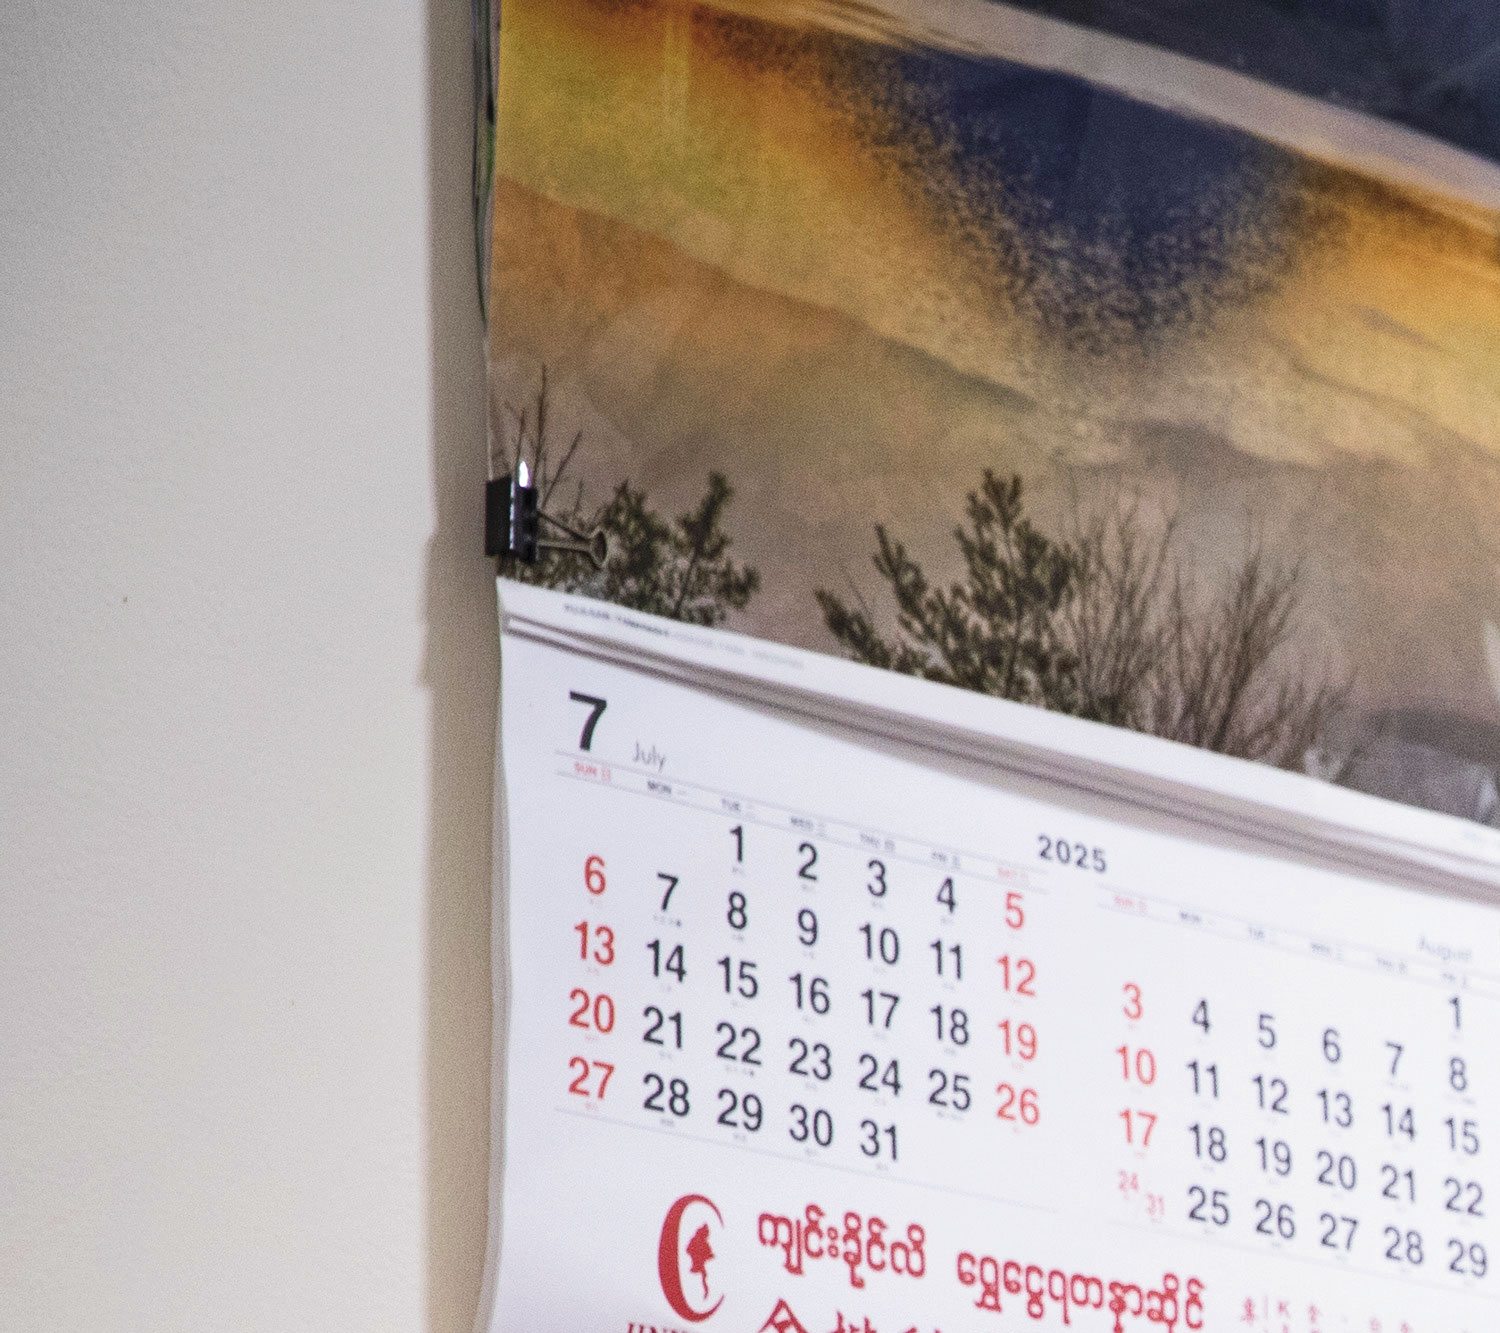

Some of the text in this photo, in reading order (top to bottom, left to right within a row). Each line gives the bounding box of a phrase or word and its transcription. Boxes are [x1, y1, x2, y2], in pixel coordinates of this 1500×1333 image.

[568, 690, 667, 773] 7 July
[729, 824, 1026, 931] 1 2 3 4 5
[1037, 830, 1109, 876] 2025
[583, 854, 1037, 998] 6 7 8 9 10 11 12
[574, 920, 1039, 1062] 13 14 15 16 17 18 19
[1122, 981, 1144, 1022] 3
[1191, 998, 1212, 1034] 4
[1256, 1011, 1278, 1051] 5
[1320, 1026, 1343, 1066] 6
[1384, 1040, 1406, 1078] 7
[1447, 1055, 1469, 1094] 8
[1447, 994, 1463, 1031] 1
[567, 1055, 899, 1161] 27 28 29 30 31
[568, 987, 1041, 1126] 20 21 22 23 24 25 26
[1115, 1043, 1157, 1086] 10
[1186, 1059, 1220, 1099] 11
[1251, 1073, 1289, 1115] 12
[1316, 1087, 1355, 1130] 13
[1381, 1102, 1417, 1141] 14
[1443, 1115, 1481, 1157] 15
[1118, 1107, 1159, 1148] 17
[1188, 1122, 1229, 1164] 18
[1254, 1136, 1293, 1178] 19
[1315, 1148, 1358, 1192] 20
[1380, 1162, 1416, 1202] 21
[1443, 1176, 1484, 1218] 22
[1187, 1184, 1231, 1227] 25
[1254, 1197, 1297, 1240] 26
[1318, 1211, 1360, 1251] 27
[1382, 1224, 1425, 1266] 28
[1446, 1237, 1489, 1279] 29
